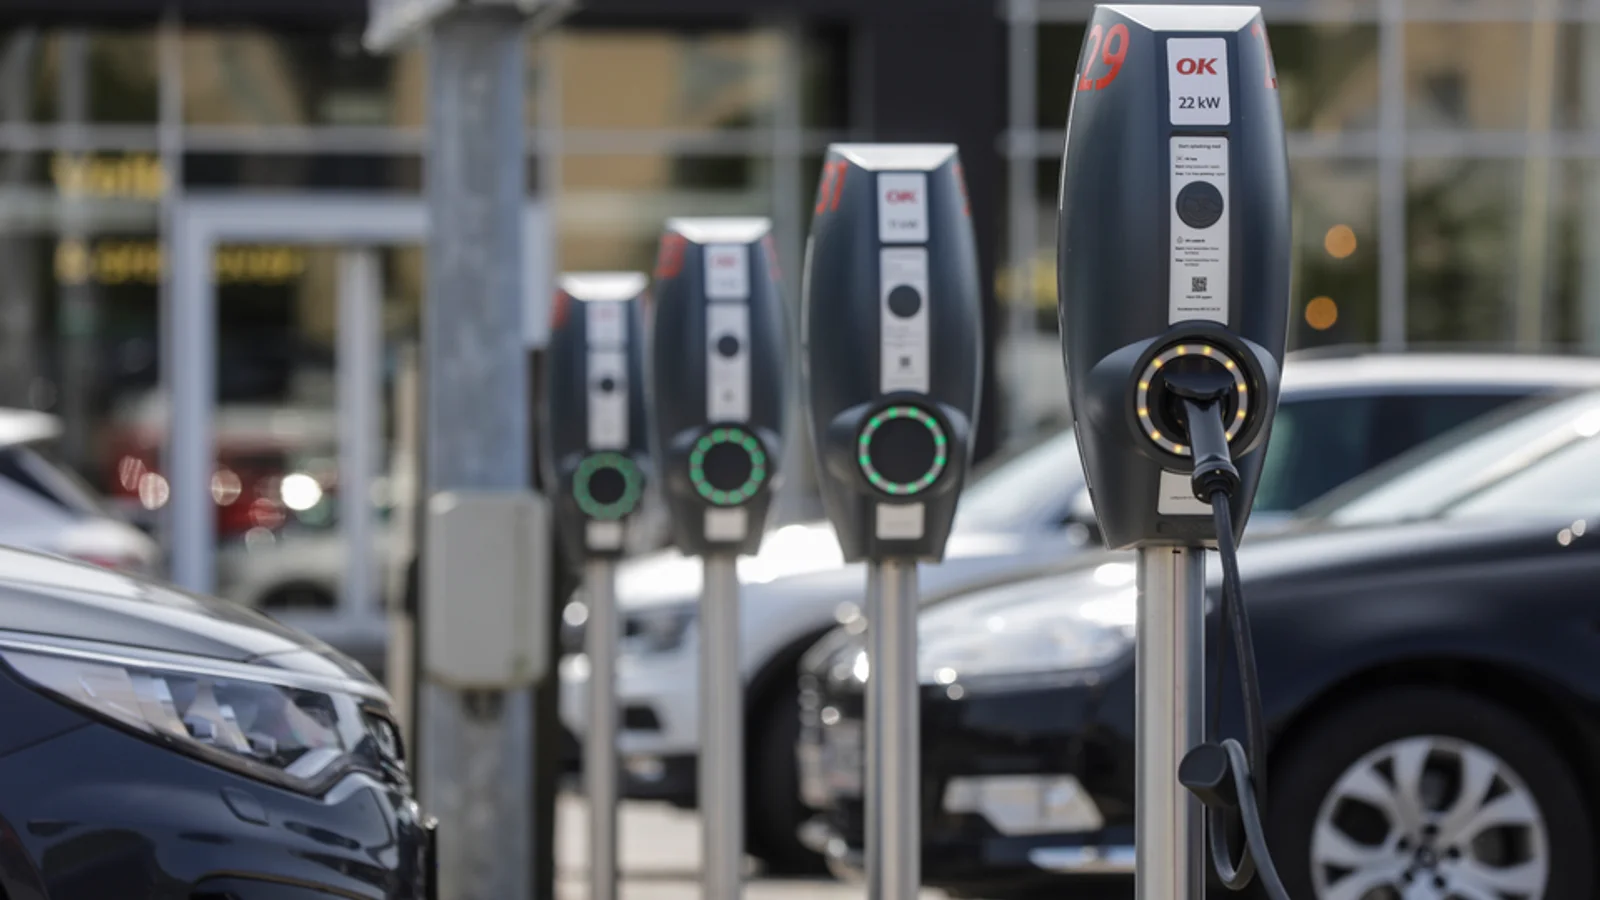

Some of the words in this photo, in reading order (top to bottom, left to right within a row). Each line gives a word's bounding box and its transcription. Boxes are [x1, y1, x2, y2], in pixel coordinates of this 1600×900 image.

[1077, 23, 1131, 91] 29
[1175, 57, 1218, 76] OK
[1178, 96, 1195, 109] 22
[1198, 96, 1221, 109] kW
